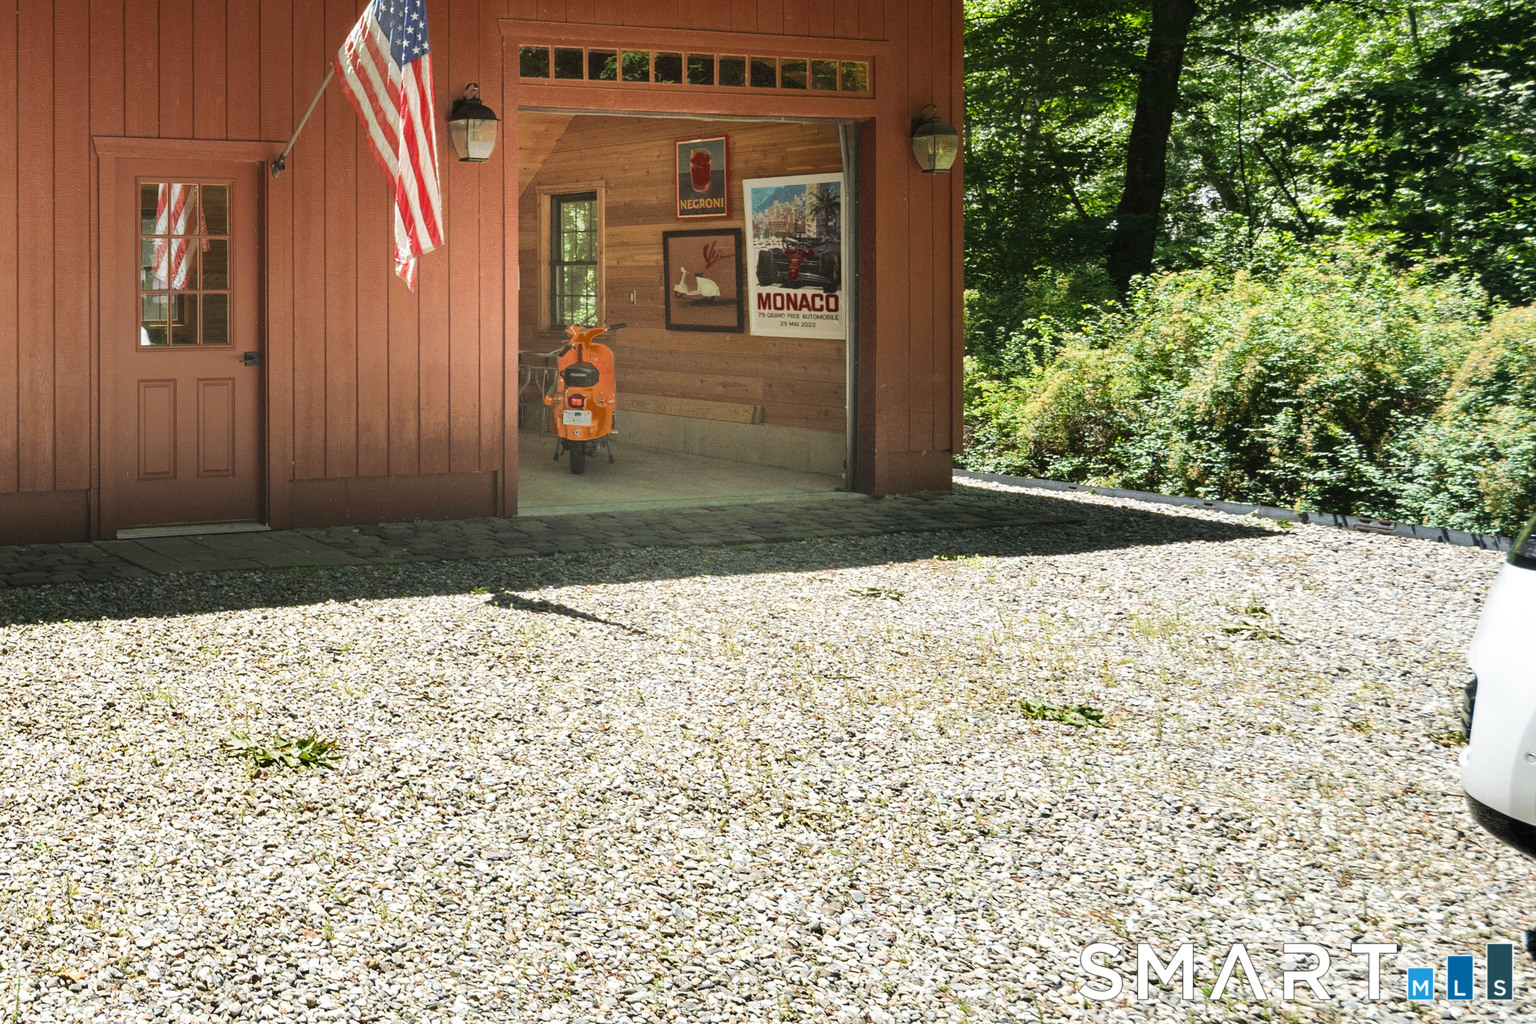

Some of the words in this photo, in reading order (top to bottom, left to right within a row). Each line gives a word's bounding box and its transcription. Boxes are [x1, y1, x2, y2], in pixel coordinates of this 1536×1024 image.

[680, 197, 724, 210] NEGRONI
[757, 292, 839, 312] MONACO
[802, 313, 839, 321] AUTOMOBILE
